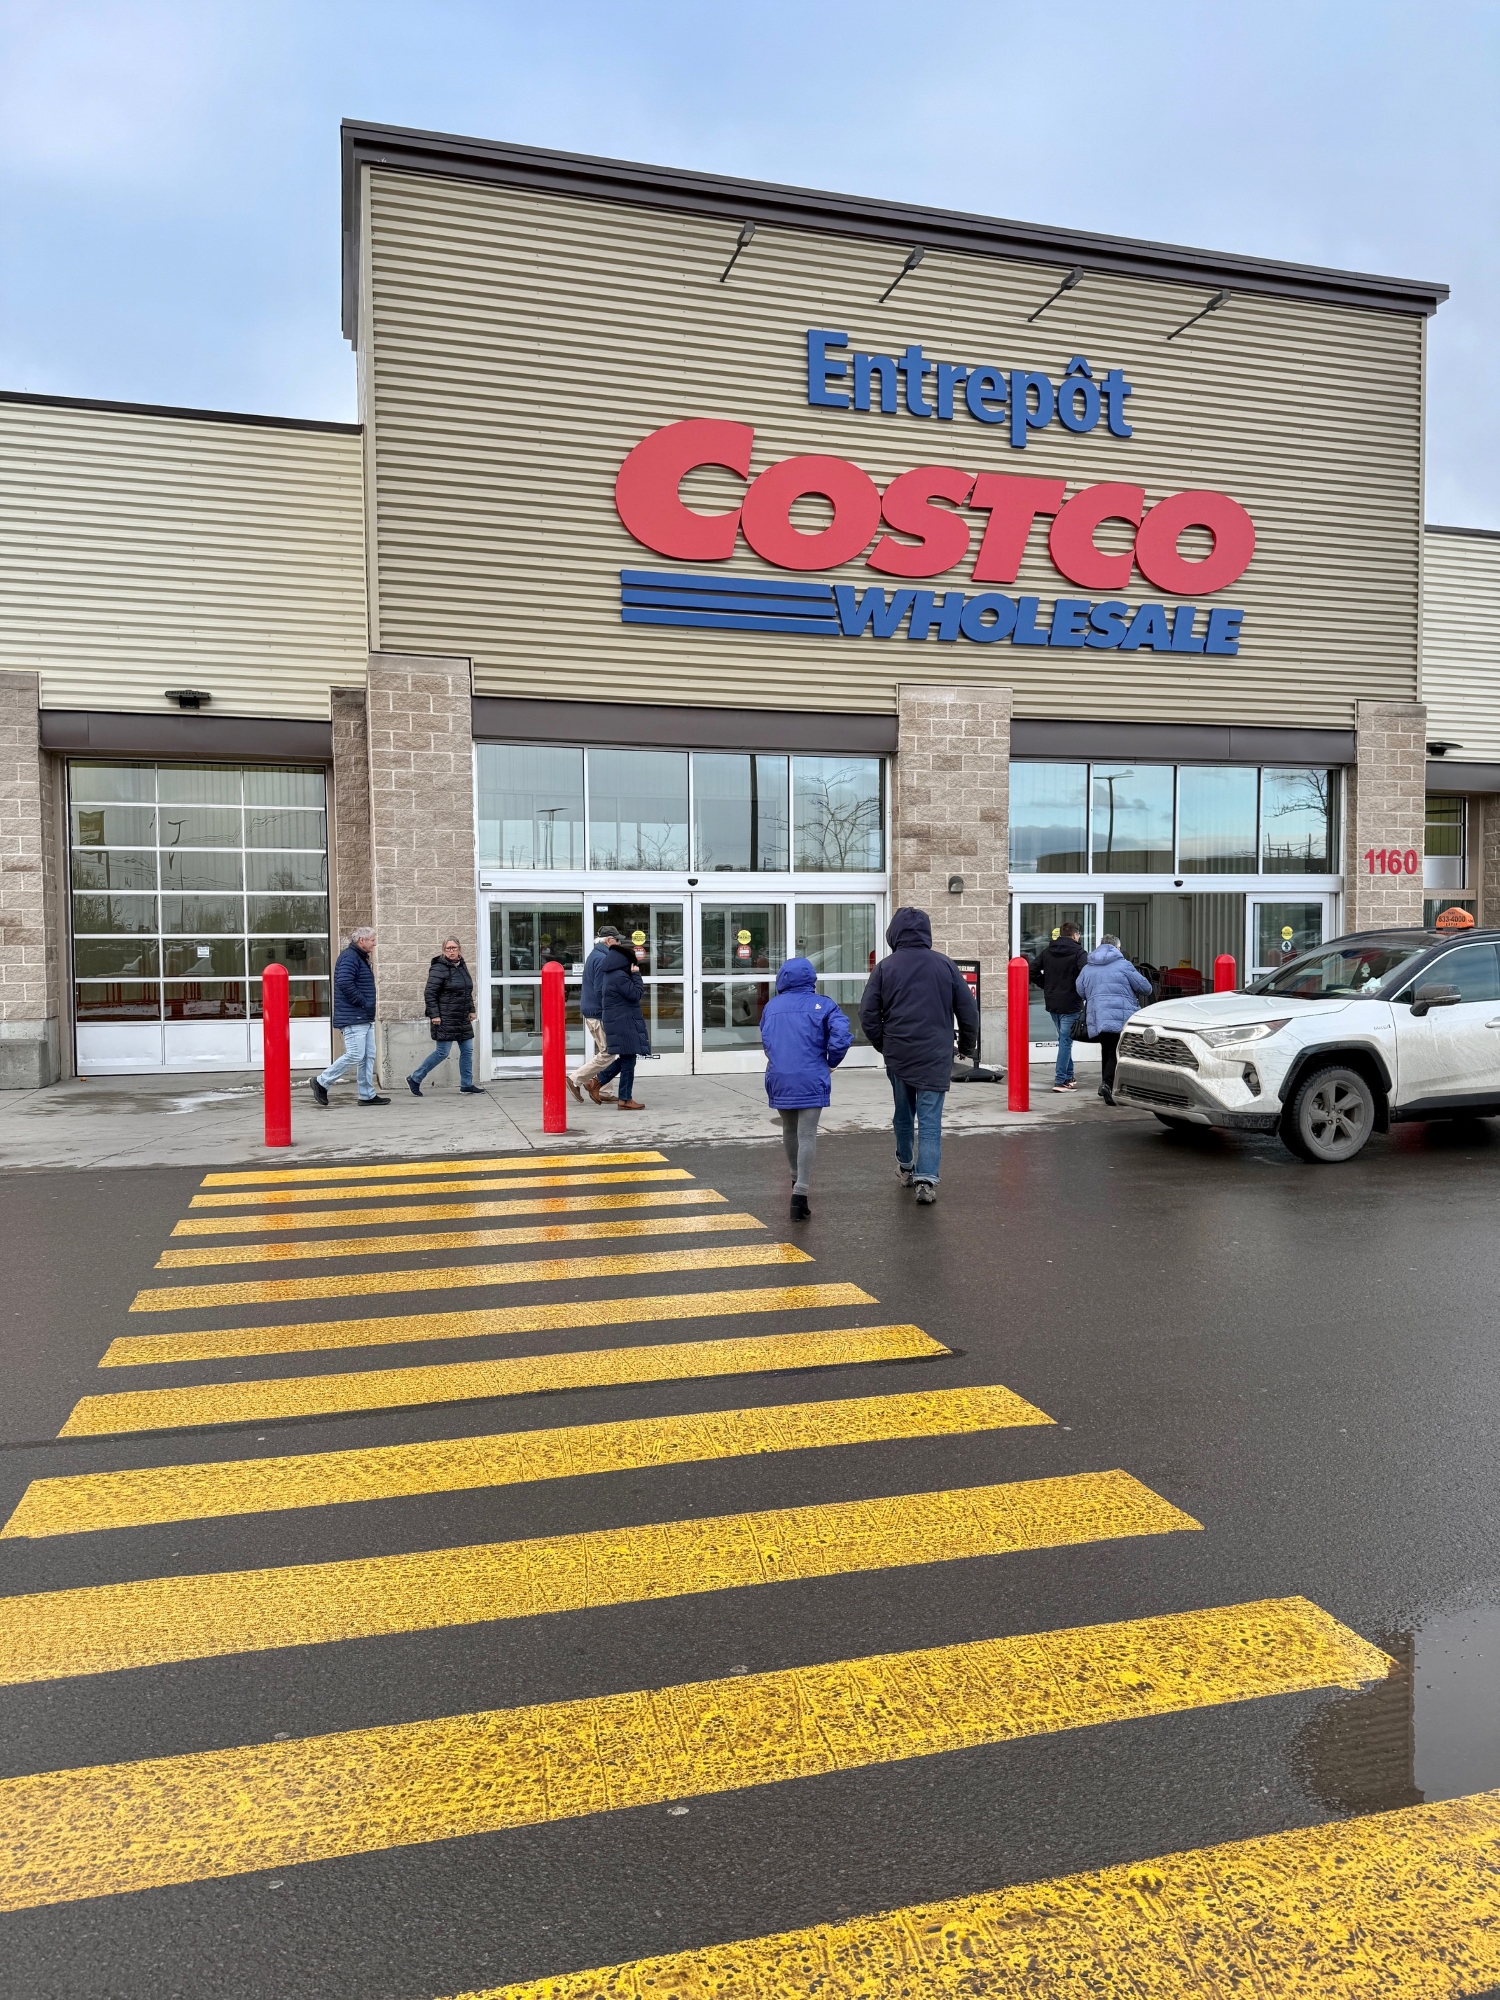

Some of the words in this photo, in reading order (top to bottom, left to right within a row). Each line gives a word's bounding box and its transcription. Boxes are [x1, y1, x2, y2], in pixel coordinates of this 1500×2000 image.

[806, 329, 1132, 448] Entrepôt
[613, 417, 1256, 596] COSTCO
[833, 584, 1244, 657] WHOLESALE
[1364, 848, 1418, 875] 1160
